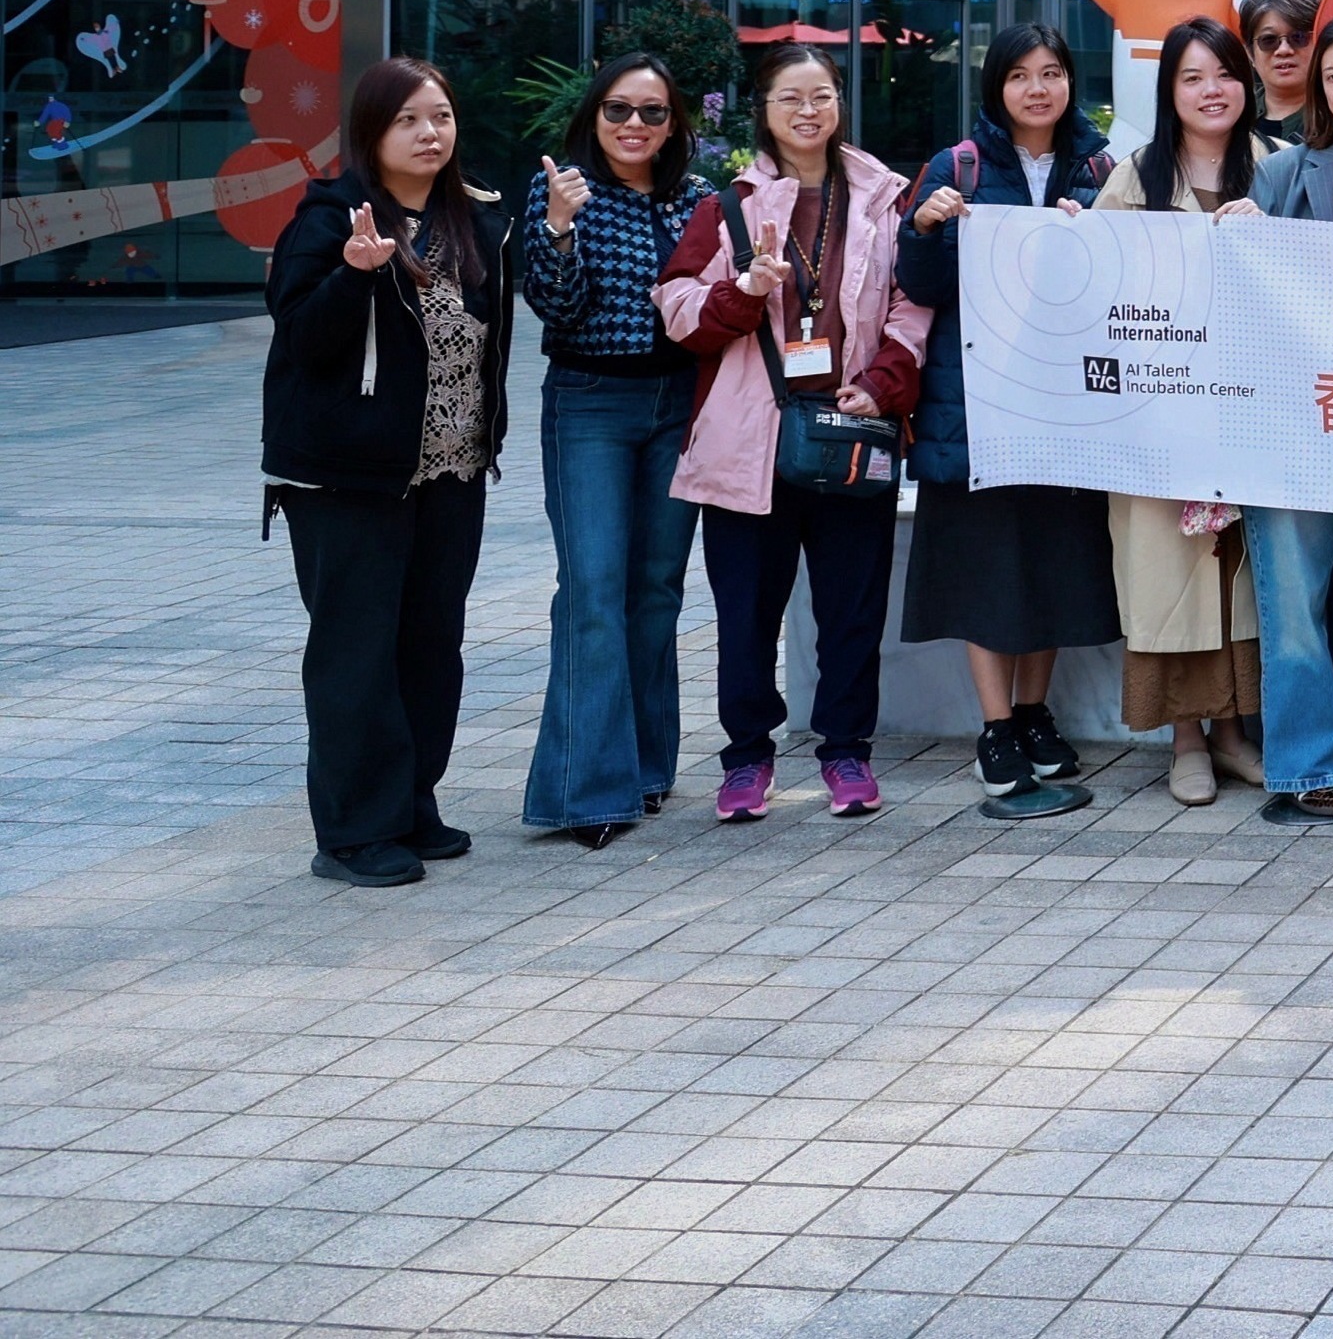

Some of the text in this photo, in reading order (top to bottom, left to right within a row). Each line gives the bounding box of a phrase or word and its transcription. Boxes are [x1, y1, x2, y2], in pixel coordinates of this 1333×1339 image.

[1107, 304, 1170, 322] Alibaba
[1107, 324, 1208, 343] International
[1125, 363, 1191, 378] AI Talent
[1126, 380, 1256, 398] Incubation Center
